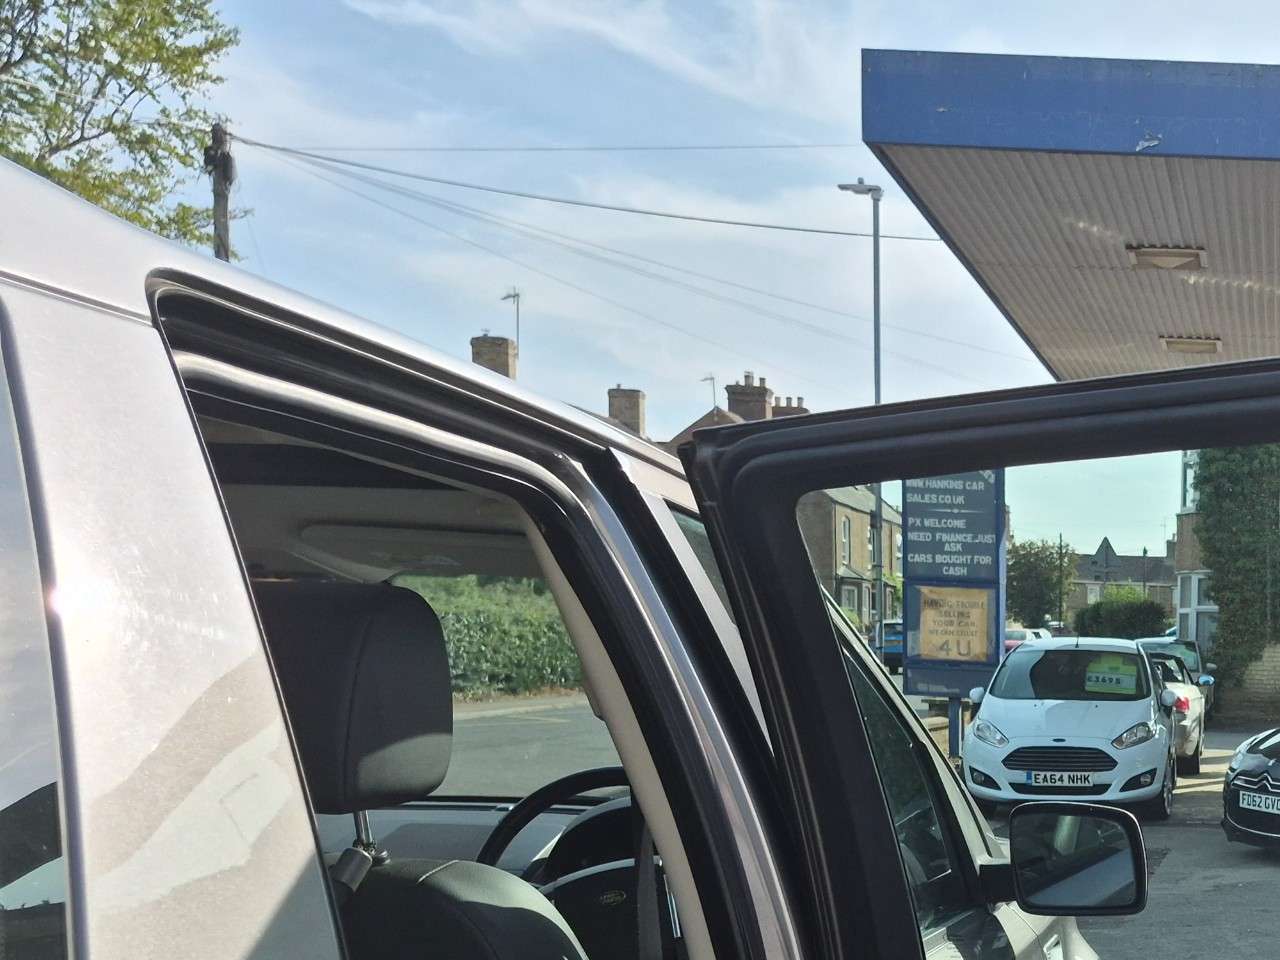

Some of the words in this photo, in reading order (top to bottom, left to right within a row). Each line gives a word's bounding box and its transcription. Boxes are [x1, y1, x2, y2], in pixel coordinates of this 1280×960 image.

[966, 481, 985, 491] CAR
[908, 517, 922, 527] PX
[924, 518, 967, 528] WELCOME
[908, 532, 932, 541] NEED
[944, 543, 963, 552] ASK
[907, 554, 933, 563] CARS
[935, 555, 972, 564] BOUGHT
[974, 556, 992, 565] FOR
[942, 567, 968, 576] CASH
[939, 640, 952, 656] 4
[957, 640, 971, 656] U
[1034, 773, 1064, 784] EA64
[1067, 774, 1091, 784] NHK
